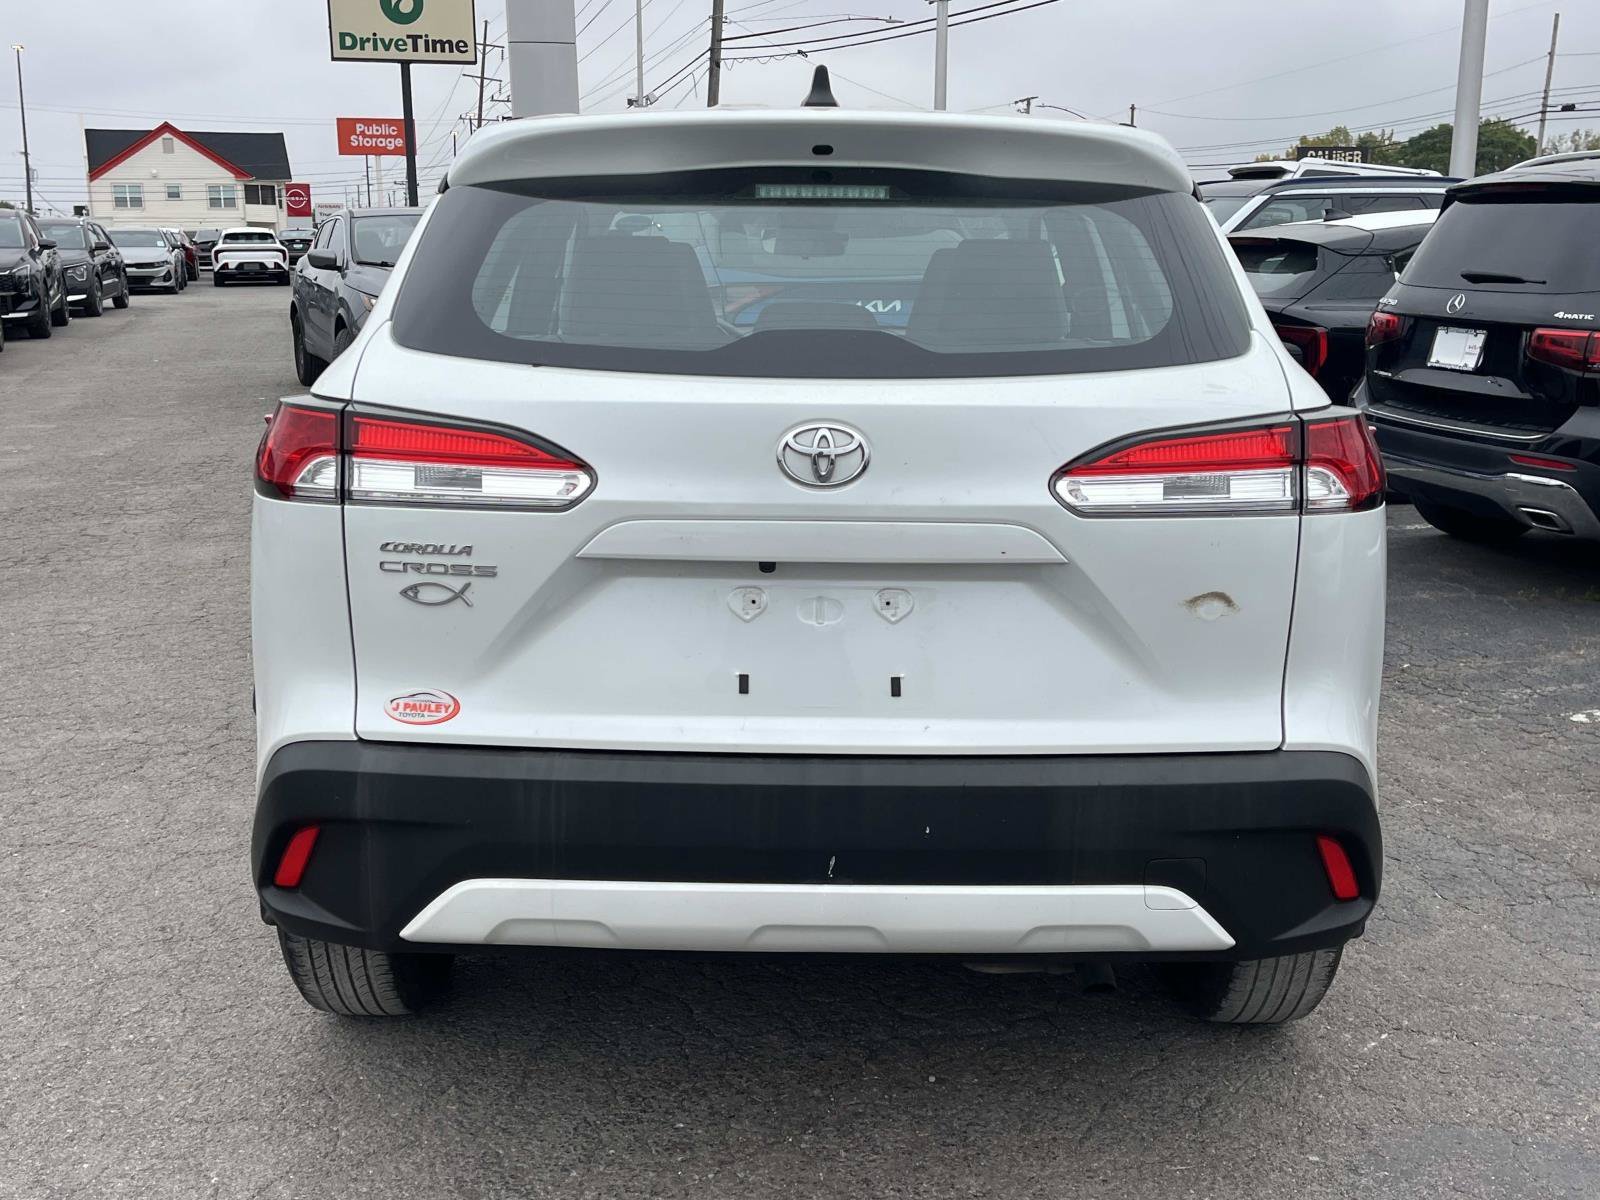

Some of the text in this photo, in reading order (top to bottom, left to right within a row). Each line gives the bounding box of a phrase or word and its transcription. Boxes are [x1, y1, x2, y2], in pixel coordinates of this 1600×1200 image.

[339, 32, 469, 54] DriveTime
[356, 123, 398, 136] Public
[350, 135, 404, 150] Storage
[1553, 311, 1595, 320] 4MATIC
[379, 541, 473, 556] COROLLA
[379, 561, 498, 578] CROSS
[391, 702, 452, 714] J PAULEY
